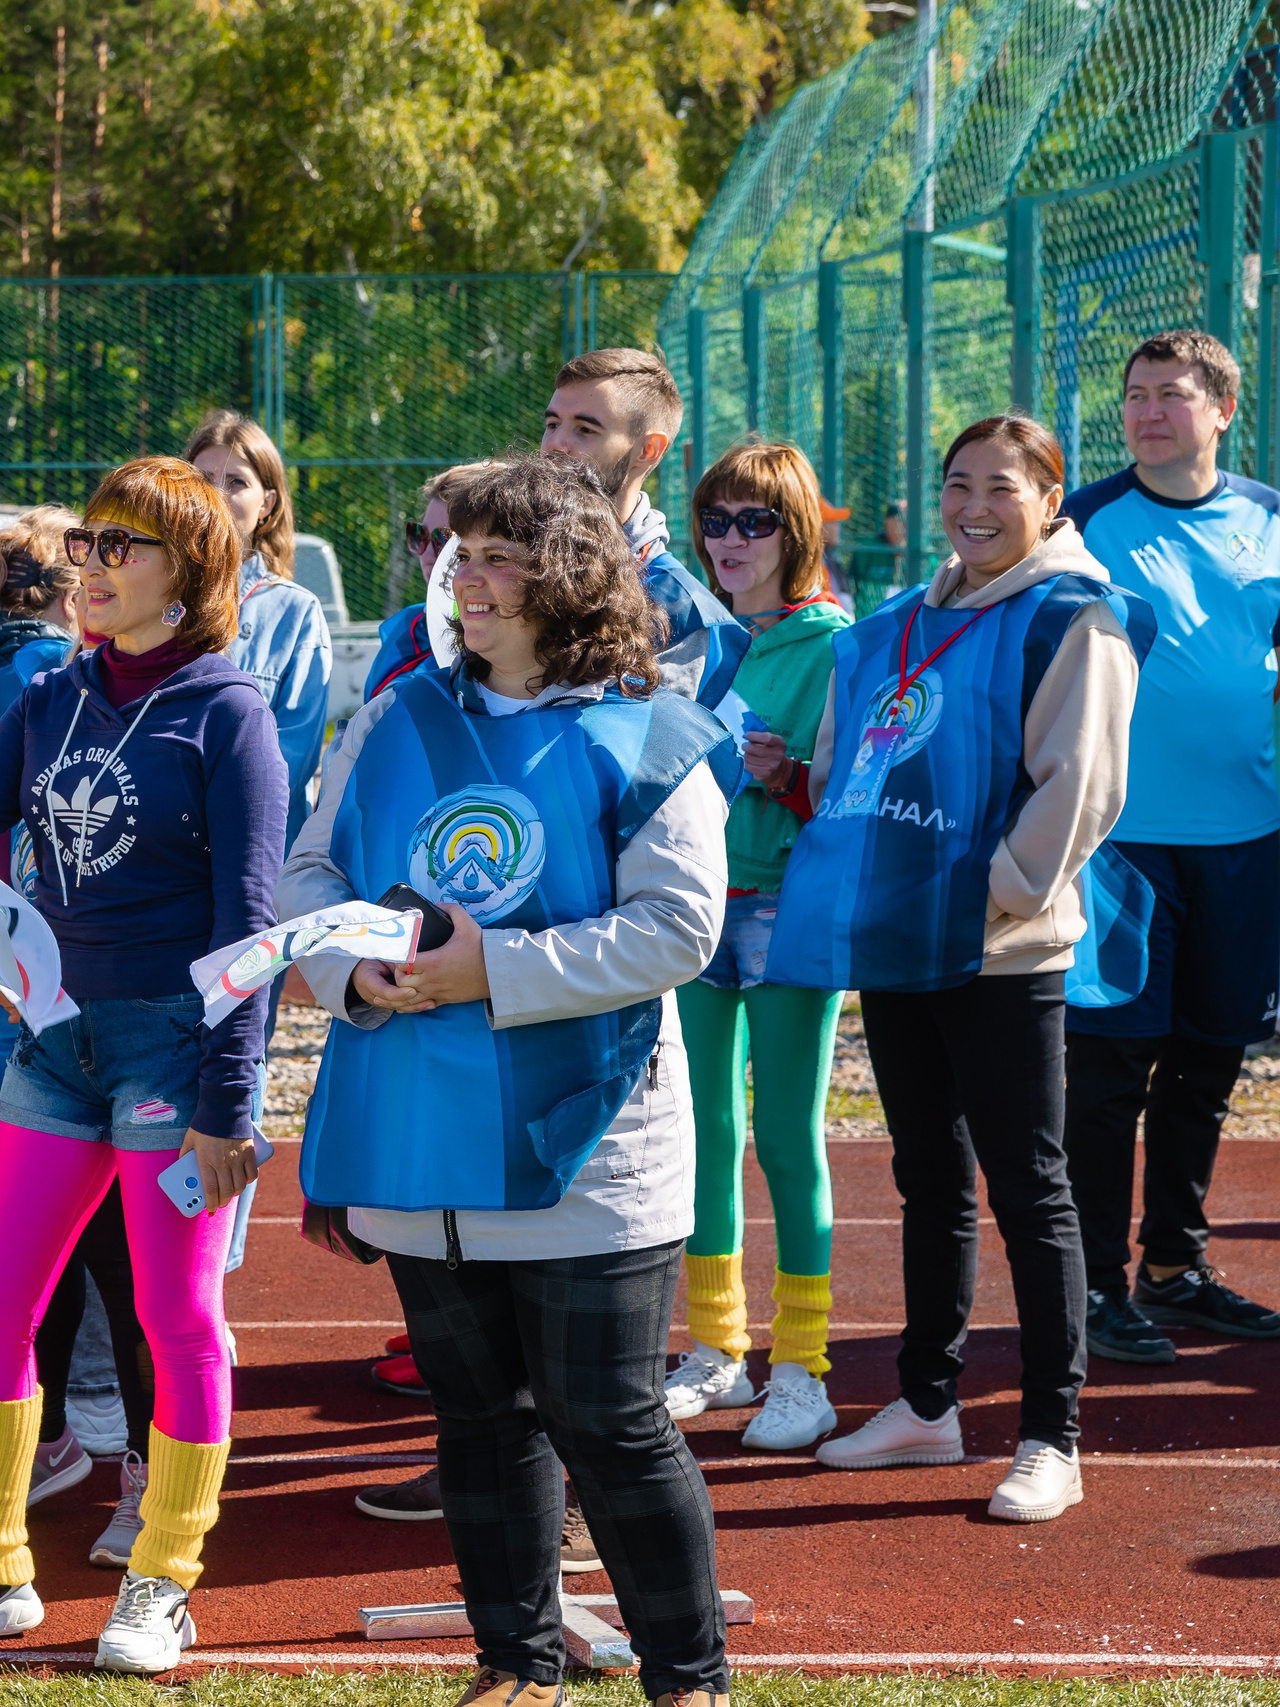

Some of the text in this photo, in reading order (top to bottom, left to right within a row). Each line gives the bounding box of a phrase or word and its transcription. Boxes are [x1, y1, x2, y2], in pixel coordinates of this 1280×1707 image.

[86, 747, 139, 806] ORIINALS
[38, 817, 65, 850] YER
[62, 847, 74, 867] OF
[90, 832, 137, 875] TREFOIL
